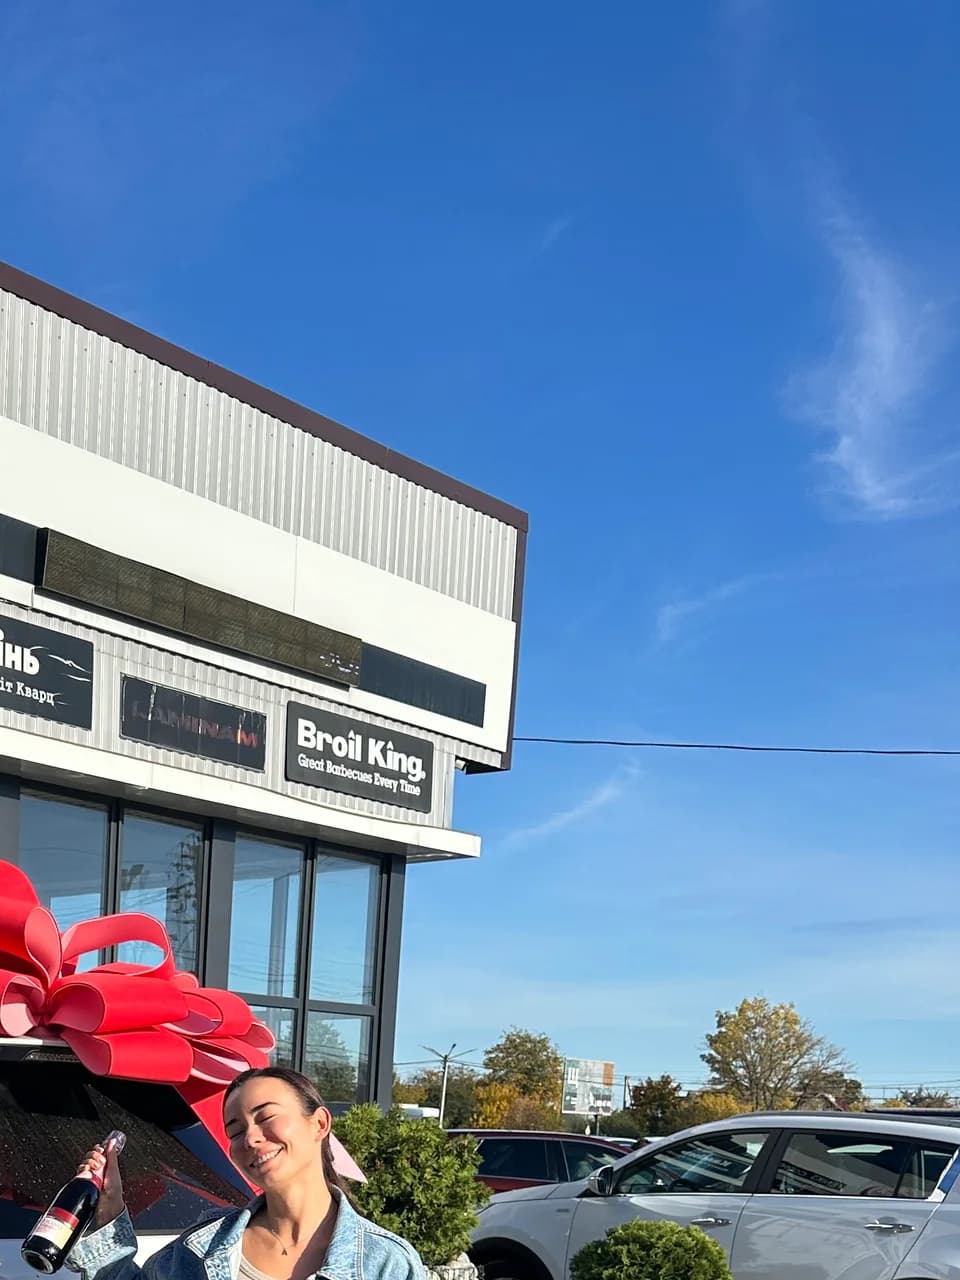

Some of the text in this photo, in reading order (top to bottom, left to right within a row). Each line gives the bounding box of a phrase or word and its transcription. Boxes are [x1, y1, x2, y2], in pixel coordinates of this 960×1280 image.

[16, 681, 55, 706] Кварц
[297, 717, 362, 761] Broil
[297, 753, 421, 796] Great Barbecues Every Time
